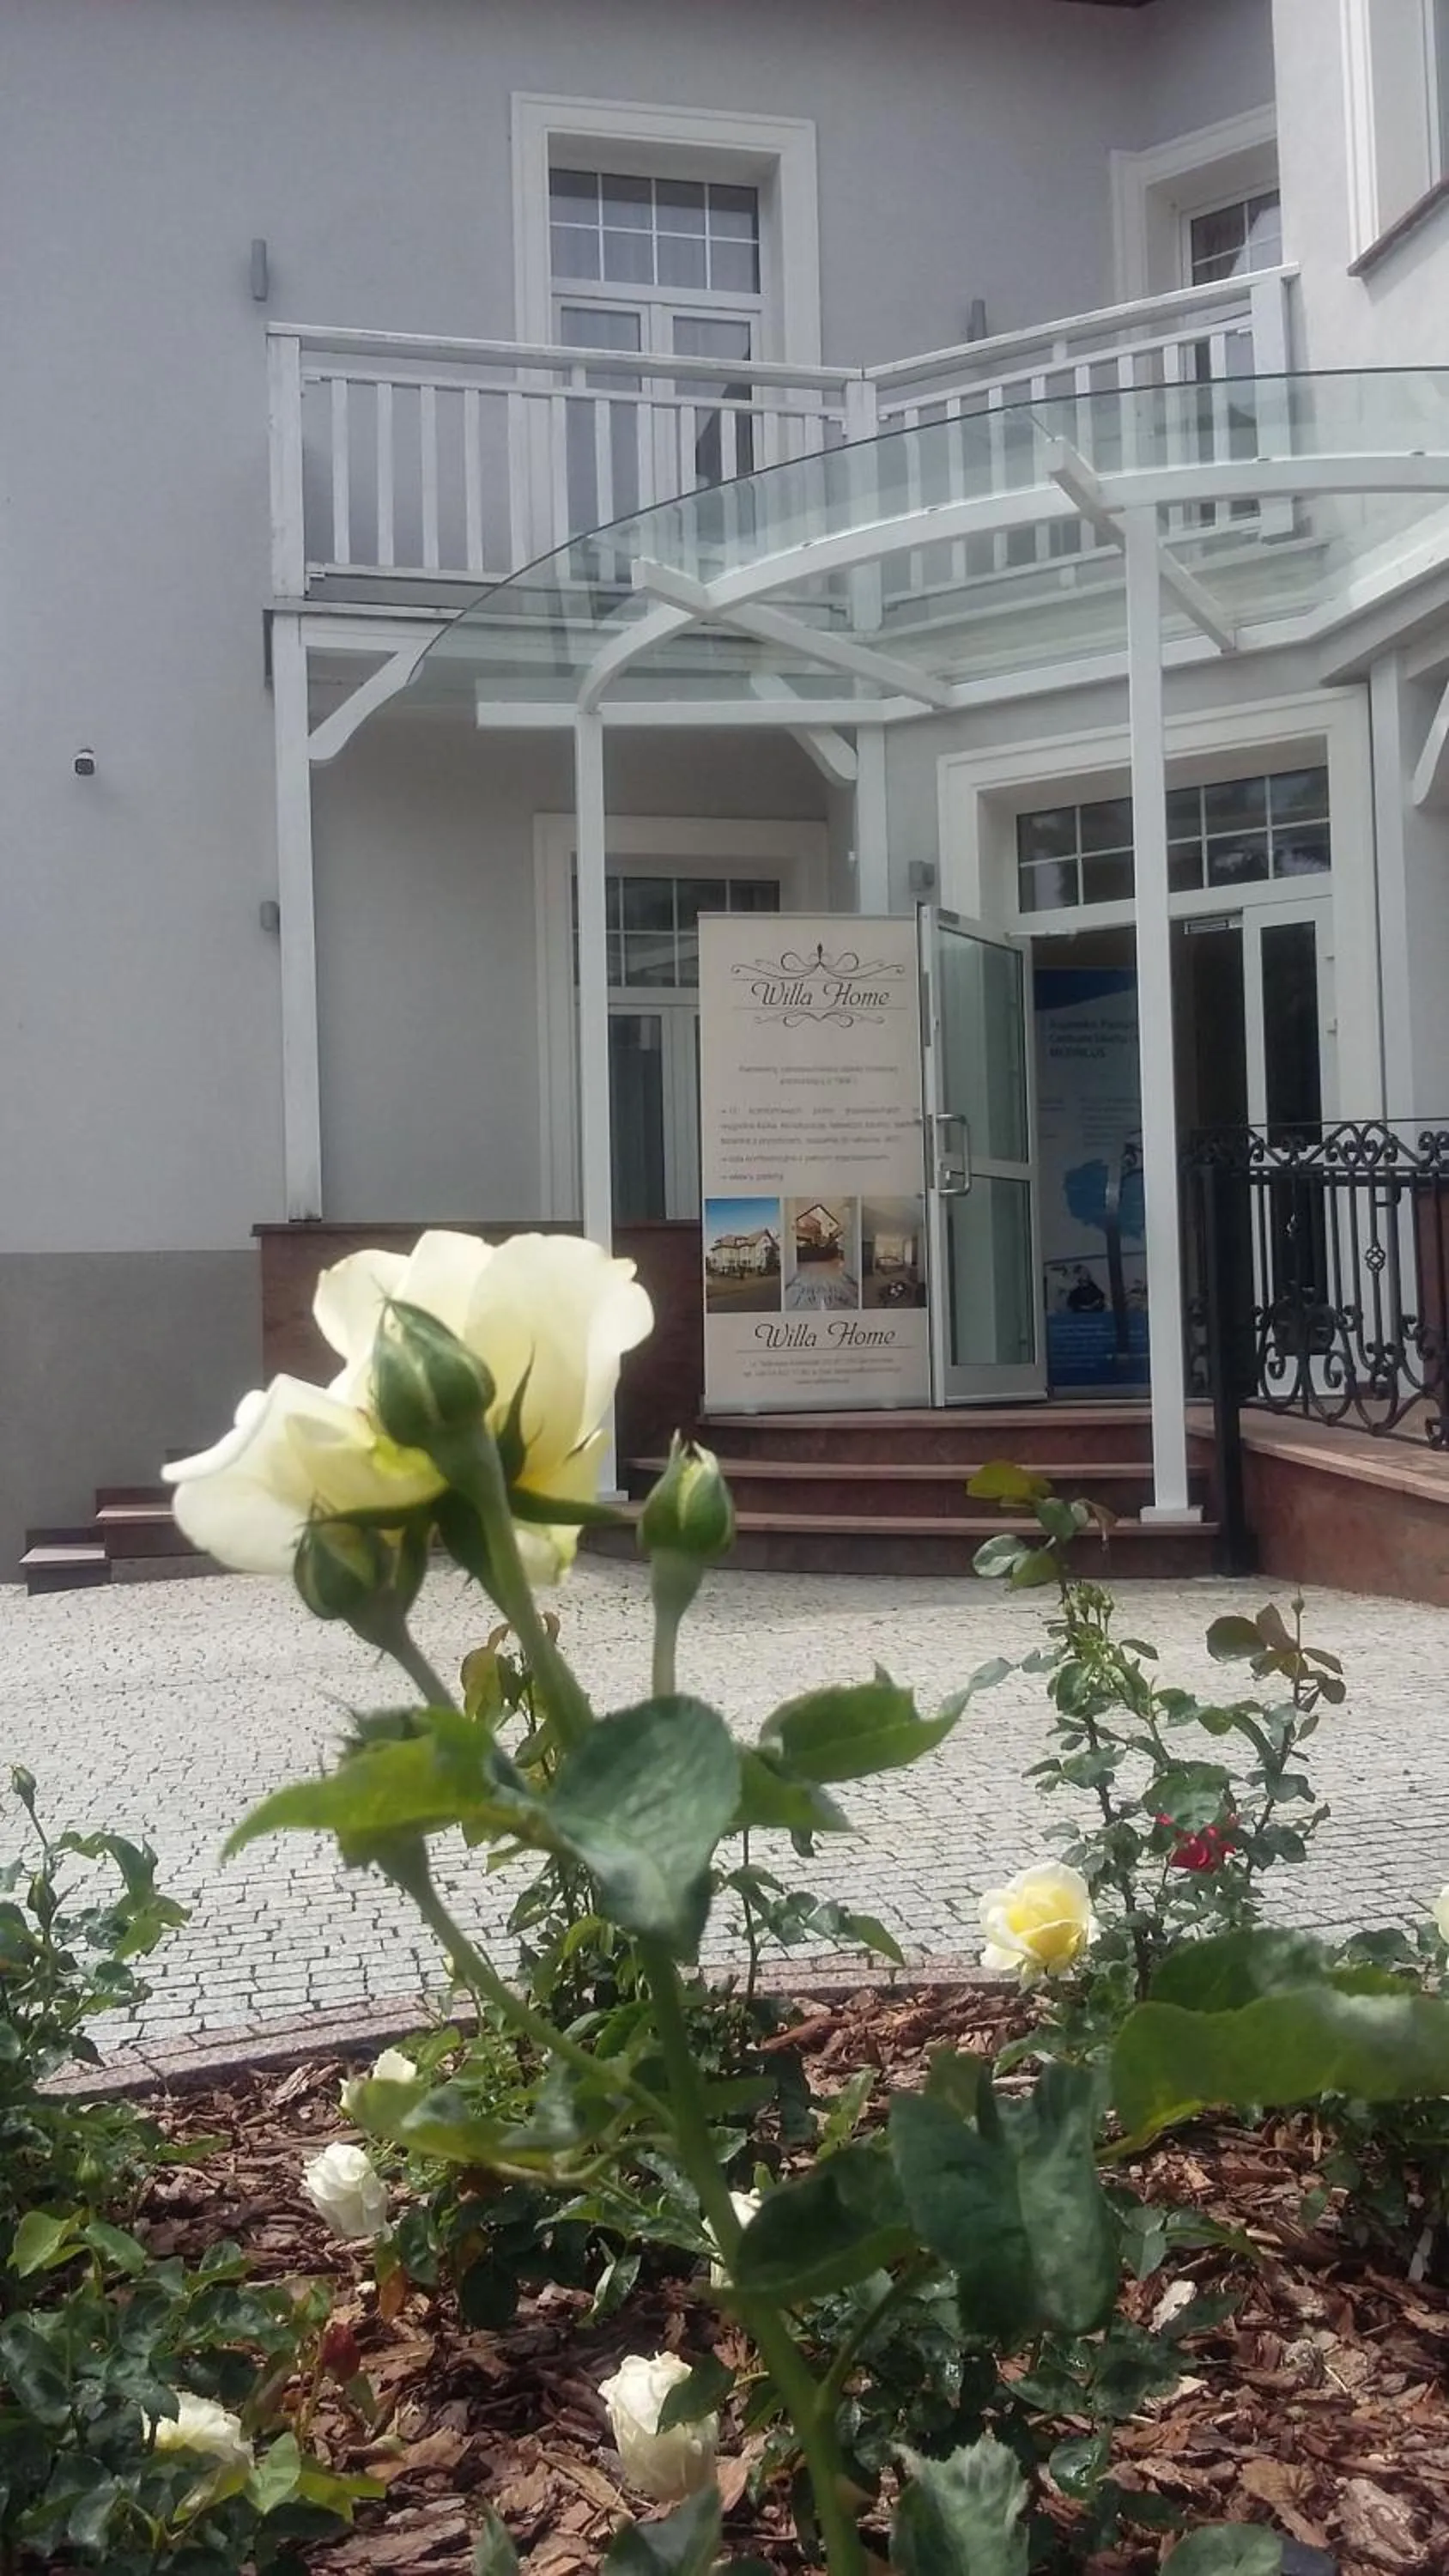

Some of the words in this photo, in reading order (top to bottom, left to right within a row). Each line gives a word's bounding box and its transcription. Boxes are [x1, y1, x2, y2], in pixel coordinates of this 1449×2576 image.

[750, 981, 814, 1006] Willa
[822, 981, 890, 1007] Home
[754, 1322, 818, 1349] Willa
[827, 1320, 896, 1349] Home
